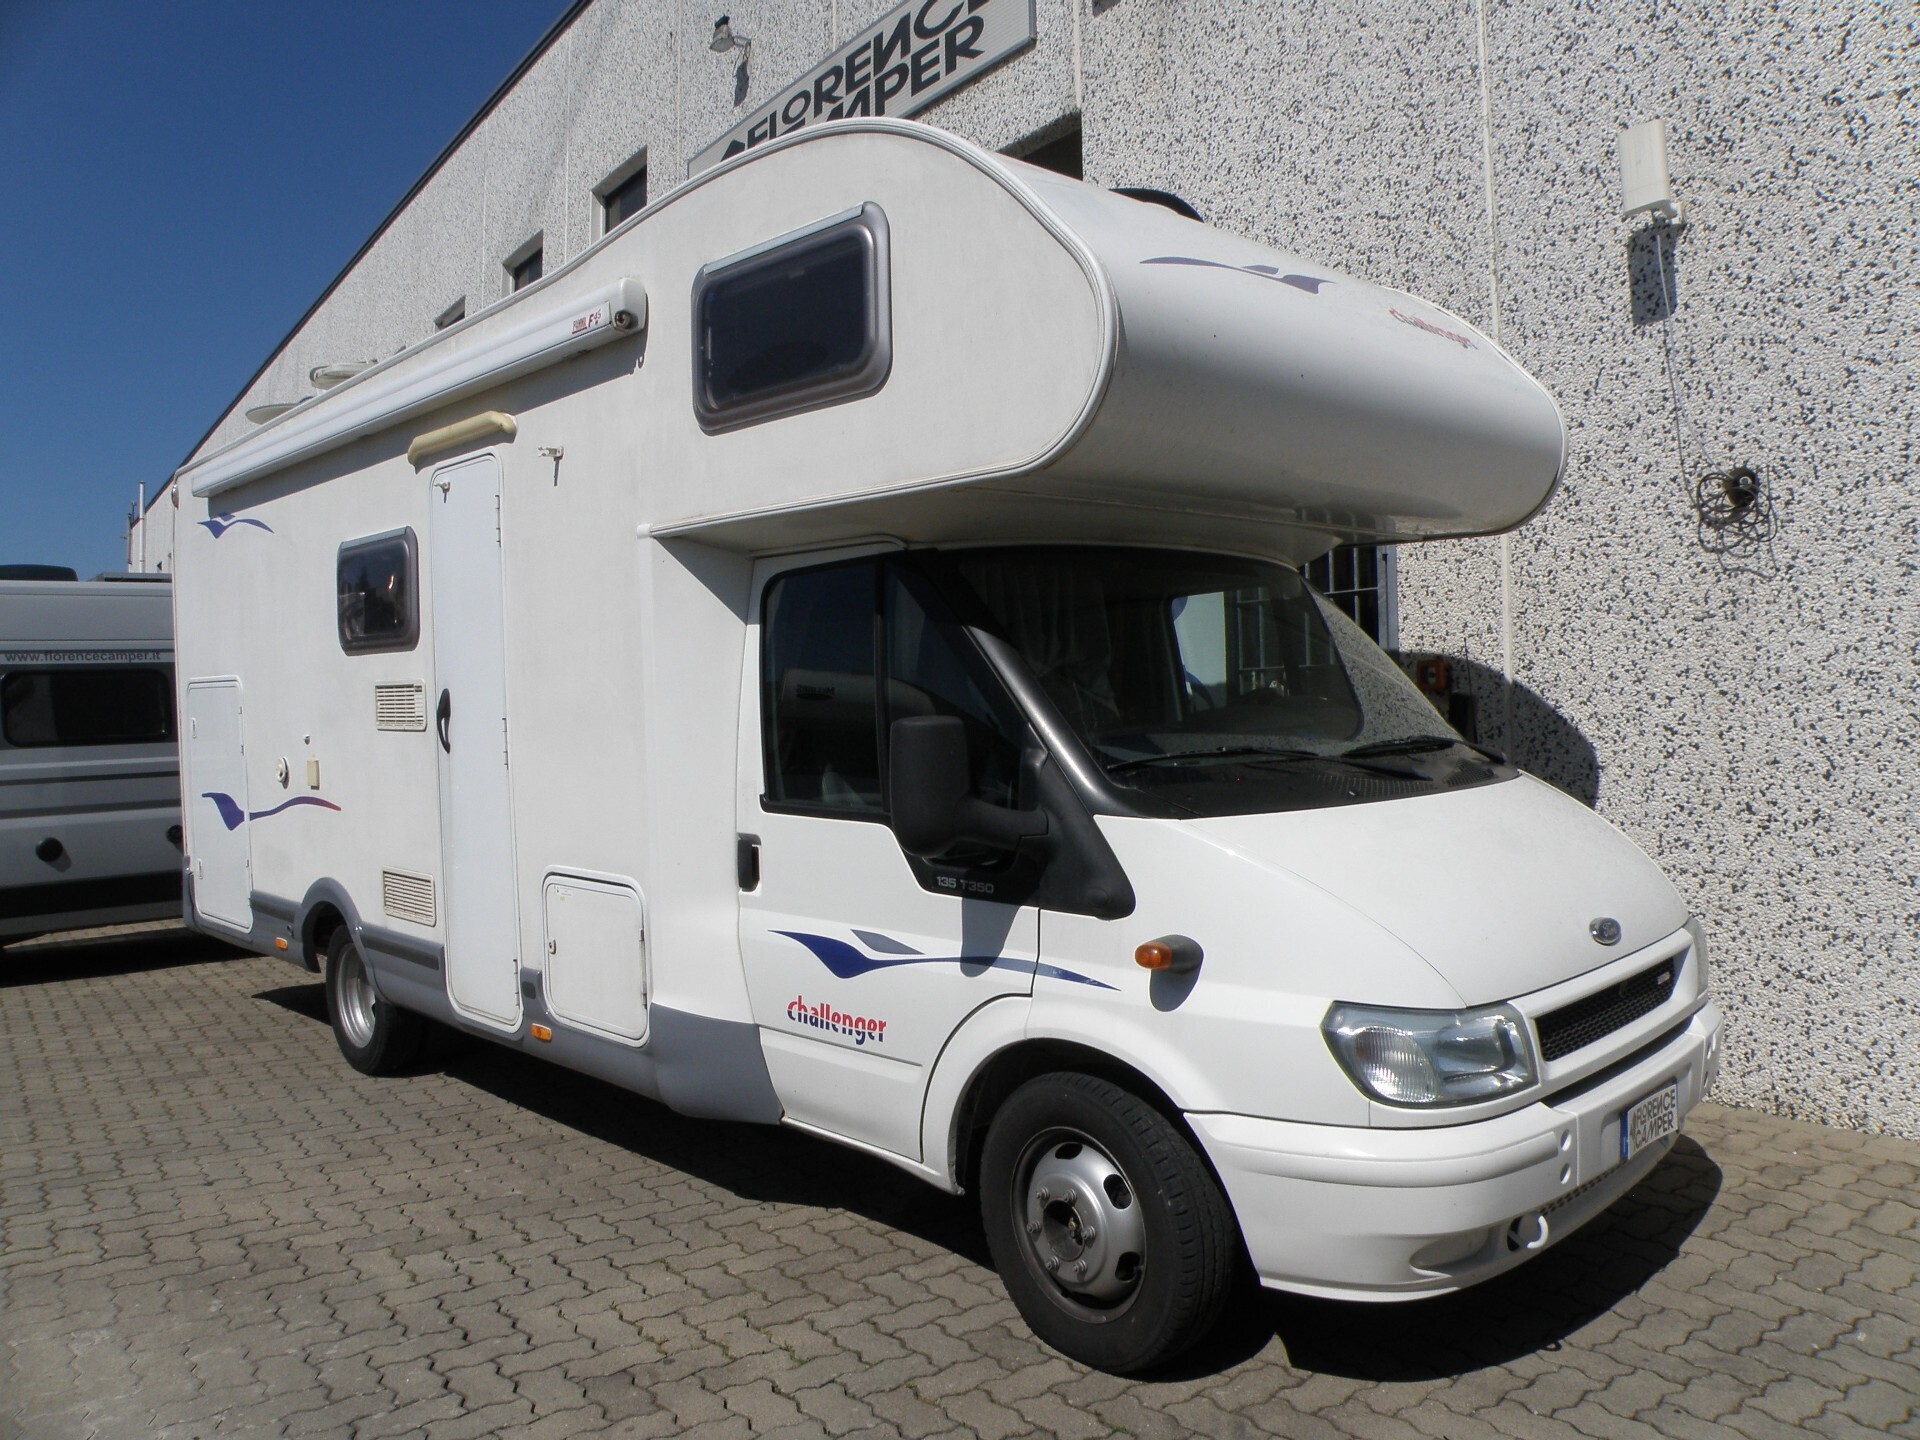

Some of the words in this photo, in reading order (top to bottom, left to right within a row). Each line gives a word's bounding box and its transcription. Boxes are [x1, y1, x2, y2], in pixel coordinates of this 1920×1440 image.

[5, 650, 161, 663] www.florencecamper.it
[936, 876, 957, 889] 135
[960, 879, 995, 894] T350
[787, 994, 887, 1046] challenger
[1636, 1088, 1676, 1127] FLORENCE
[1635, 1110, 1674, 1149] CAMPER
